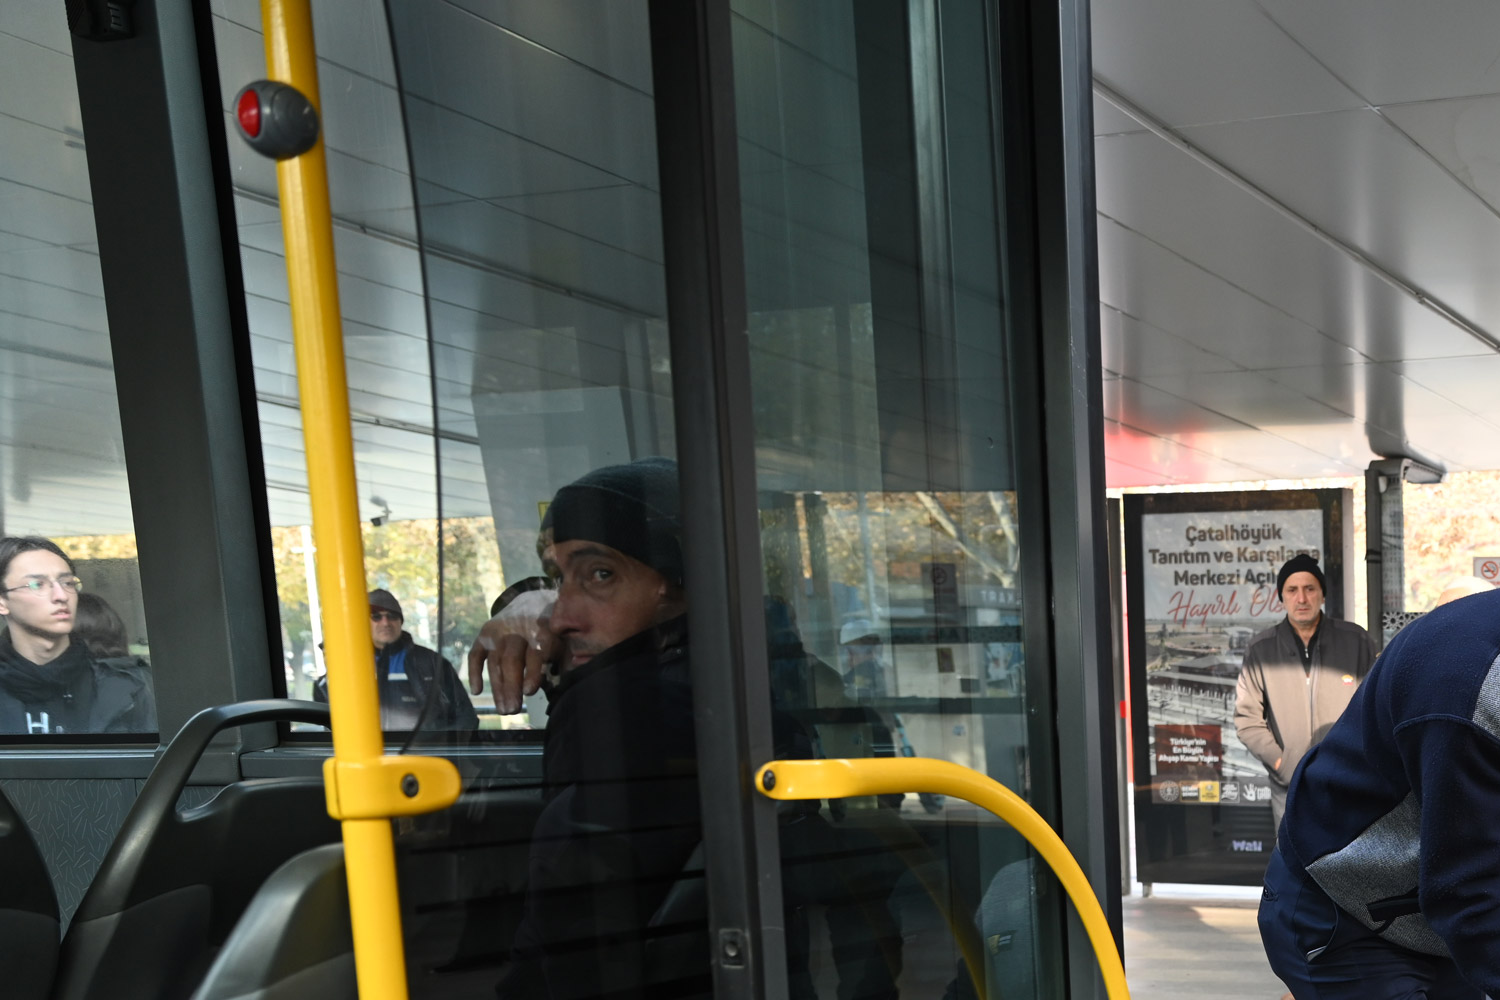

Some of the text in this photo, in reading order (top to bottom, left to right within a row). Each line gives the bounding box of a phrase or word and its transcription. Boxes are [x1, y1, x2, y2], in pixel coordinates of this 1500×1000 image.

[1185, 524, 1282, 546] Çatalhöyük
[1149, 549, 1211, 564] Tanıtım
[1213, 552, 1234, 564] ve
[1174, 568, 1278, 589] Merkezi Açıl
[1167, 585, 1286, 628] Hayırlı Ols
